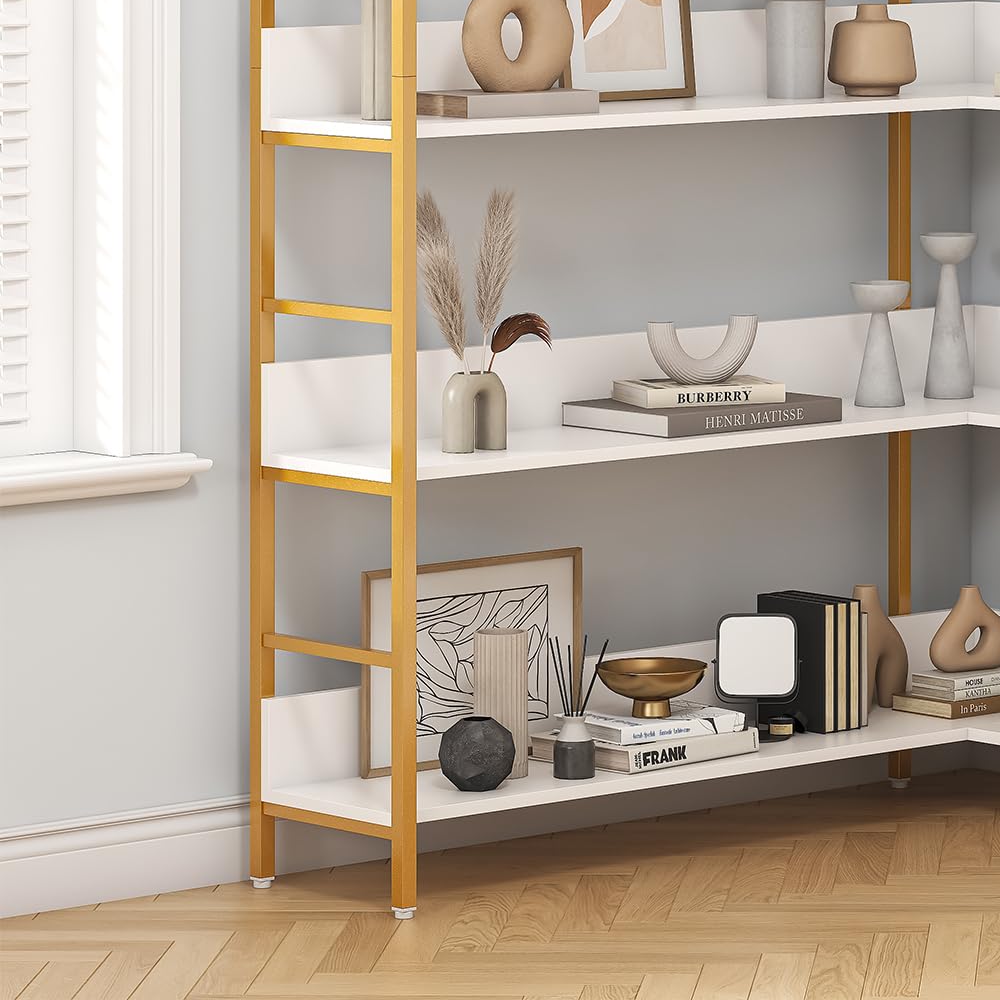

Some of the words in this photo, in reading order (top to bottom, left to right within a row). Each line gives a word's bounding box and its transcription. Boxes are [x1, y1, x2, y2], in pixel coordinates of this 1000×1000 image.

[677, 390, 753, 404] BURBERRY
[705, 413, 746, 429] HENRI
[750, 407, 805, 425] MATISSE
[965, 677, 984, 687] HOUSE
[965, 687, 992, 698] KANTHA
[960, 704, 968, 714] In
[969, 702, 987, 713] Paris
[643, 744, 688, 767] FRANK
